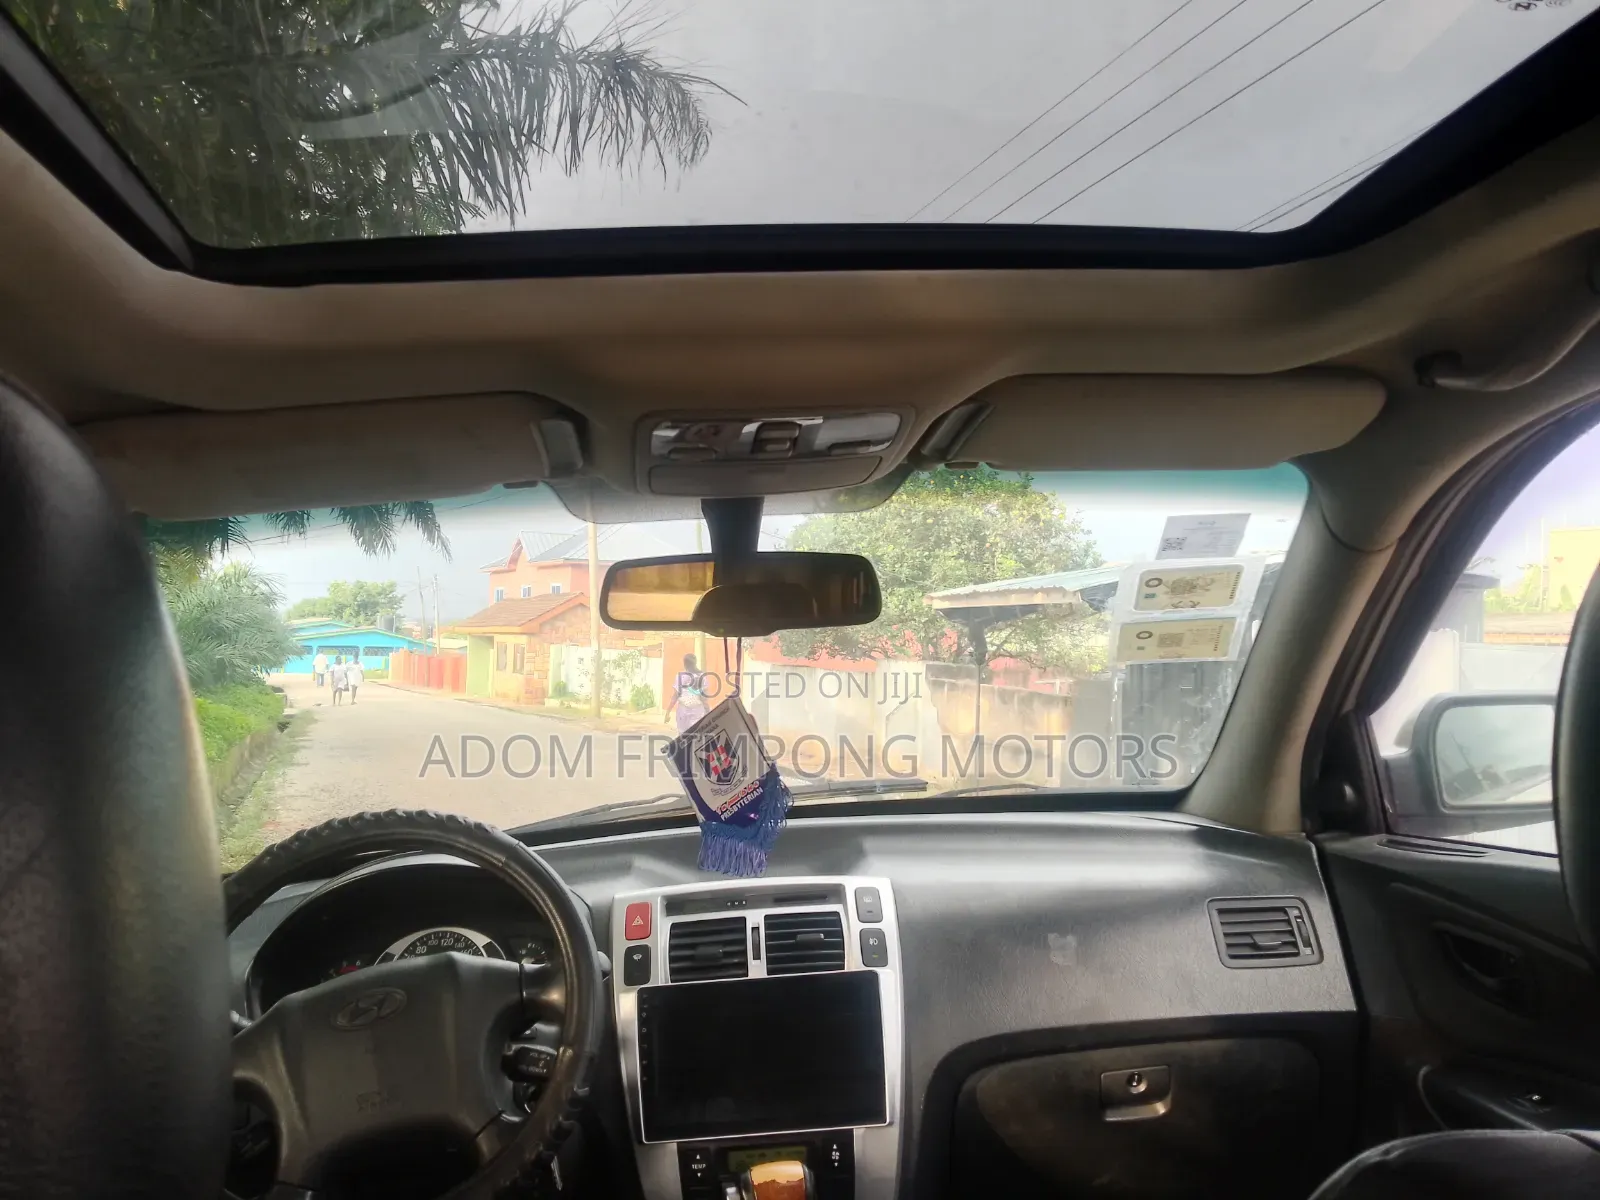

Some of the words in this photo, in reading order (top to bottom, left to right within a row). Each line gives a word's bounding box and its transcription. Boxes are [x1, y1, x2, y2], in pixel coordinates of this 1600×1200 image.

[720, 786, 764, 822] PRESBYTERIAN
[415, 946, 427, 954] 80
[440, 938, 454, 946] 120
